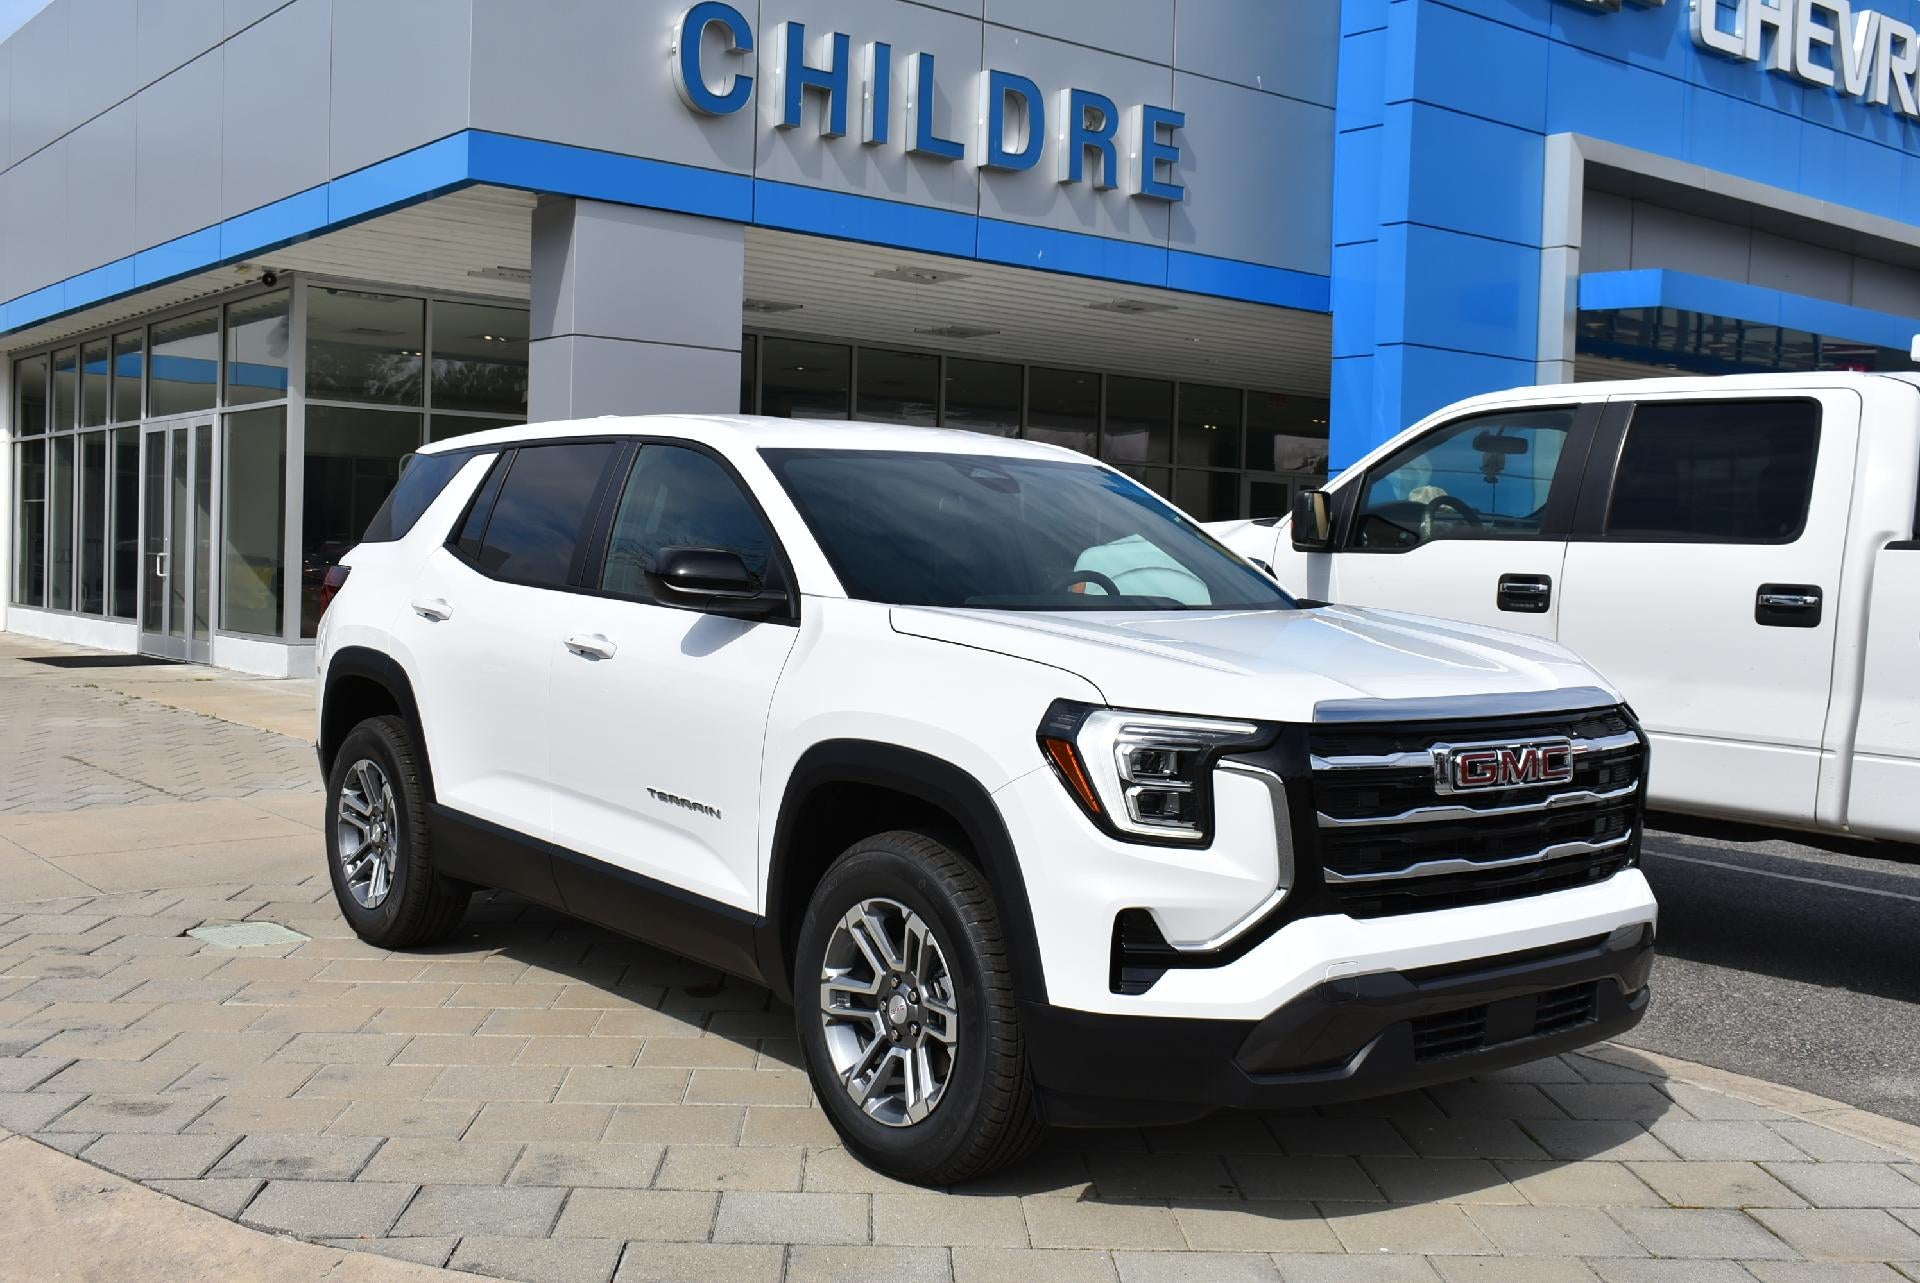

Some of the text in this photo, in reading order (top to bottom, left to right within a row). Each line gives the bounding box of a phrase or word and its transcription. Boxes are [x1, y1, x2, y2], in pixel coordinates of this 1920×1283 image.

[1690, 0, 1920, 116] CHEVR
[672, 0, 1186, 202] CHILDRE
[646, 787, 722, 820] TERRAIN
[1456, 745, 1571, 787] GMC
